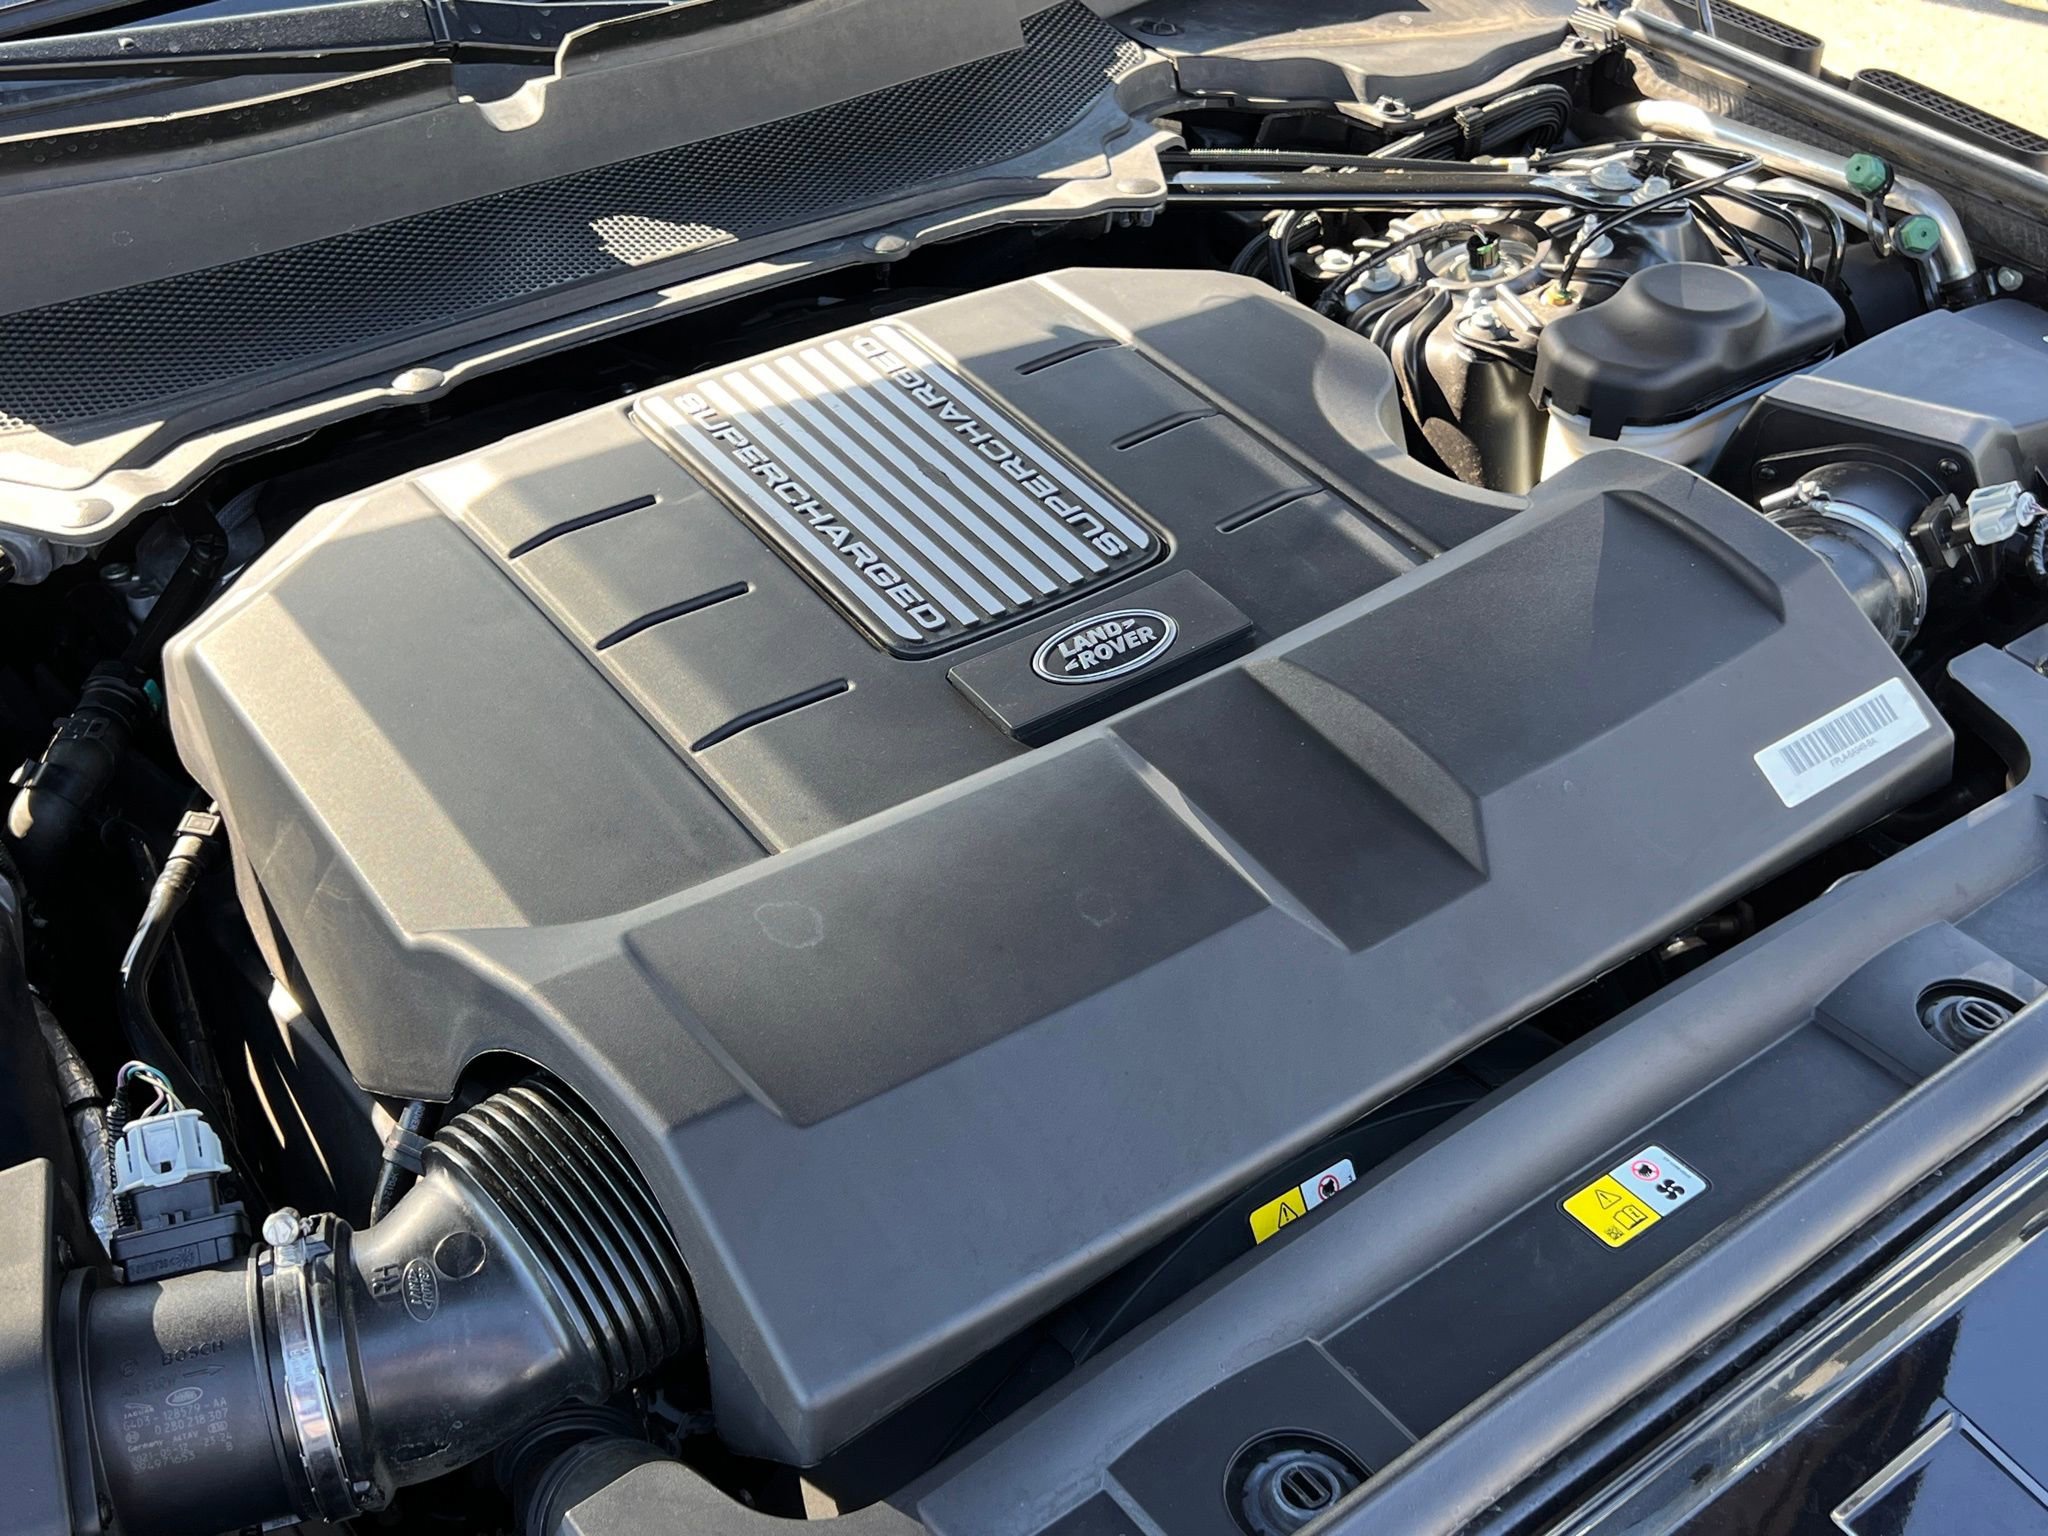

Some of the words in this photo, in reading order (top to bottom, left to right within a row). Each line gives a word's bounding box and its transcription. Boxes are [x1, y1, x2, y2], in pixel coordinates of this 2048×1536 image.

[852, 334, 1129, 557] SUPERCHARGED
[673, 391, 946, 631] SUPERCHARGED
[1057, 621, 1123, 658] LAND
[1077, 626, 1157, 670] ROVER
[162, 1340, 225, 1366] BOSCH
